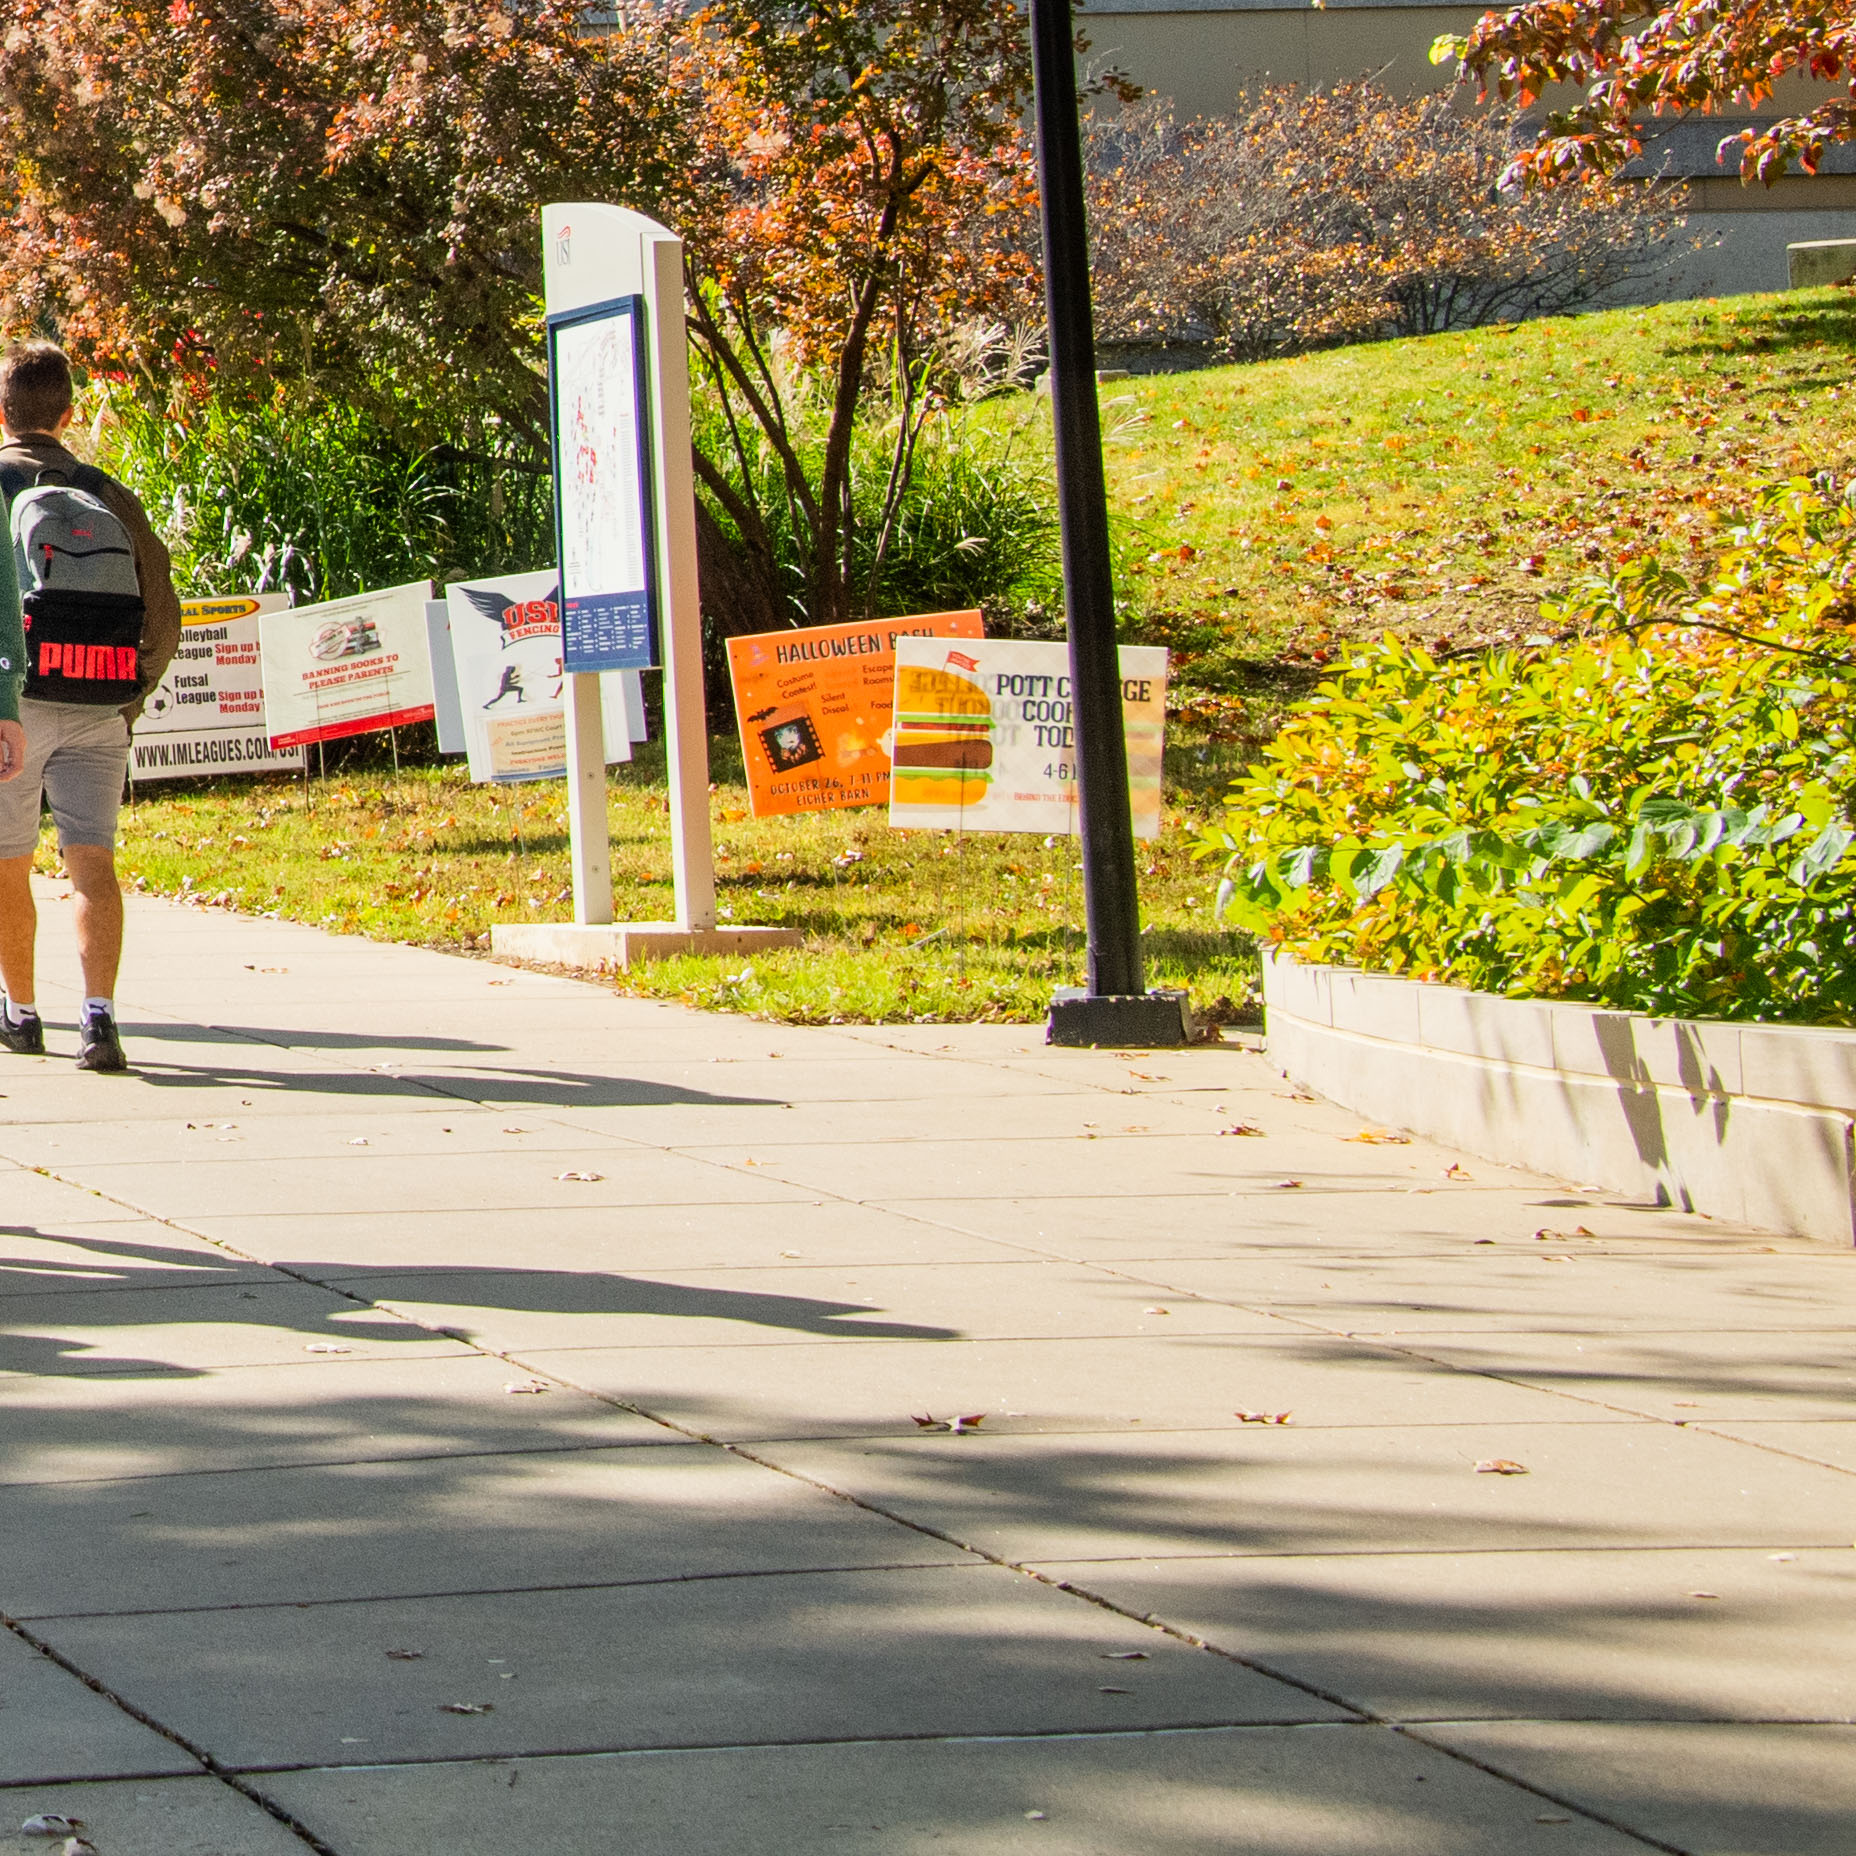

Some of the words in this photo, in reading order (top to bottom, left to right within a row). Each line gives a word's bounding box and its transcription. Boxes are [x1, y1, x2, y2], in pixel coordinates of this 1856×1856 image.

[503, 600, 559, 631] USI
[179, 627, 228, 643] olleyball
[509, 624, 560, 640] FENCING
[172, 647, 213, 660] eague
[215, 643, 238, 654] Sign
[240, 642, 254, 652] up
[776, 633, 882, 664] HALLOWEEN
[39, 642, 137, 680] PUMA
[216, 655, 257, 666] Monday
[302, 664, 348, 680] BANNING
[350, 657, 384, 670] BOOKS
[385, 653, 399, 663] TO
[309, 675, 346, 689] PLEASE
[348, 665, 394, 681] PARENTS
[862, 664, 893, 677] Escape
[174, 673, 209, 688] Futsal
[776, 671, 814, 688] Costume
[996, 674, 1053, 697] POTT
[176, 691, 216, 705] League
[218, 691, 241, 702] Sign
[244, 690, 257, 700] up
[820, 692, 846, 703] Silent
[219, 702, 260, 714] Monday
[1043, 763, 1068, 780] 4-6
[770, 778, 820, 795] OCTOBER
[796, 791, 835, 806] EICHER
[840, 788, 870, 801] BARN
